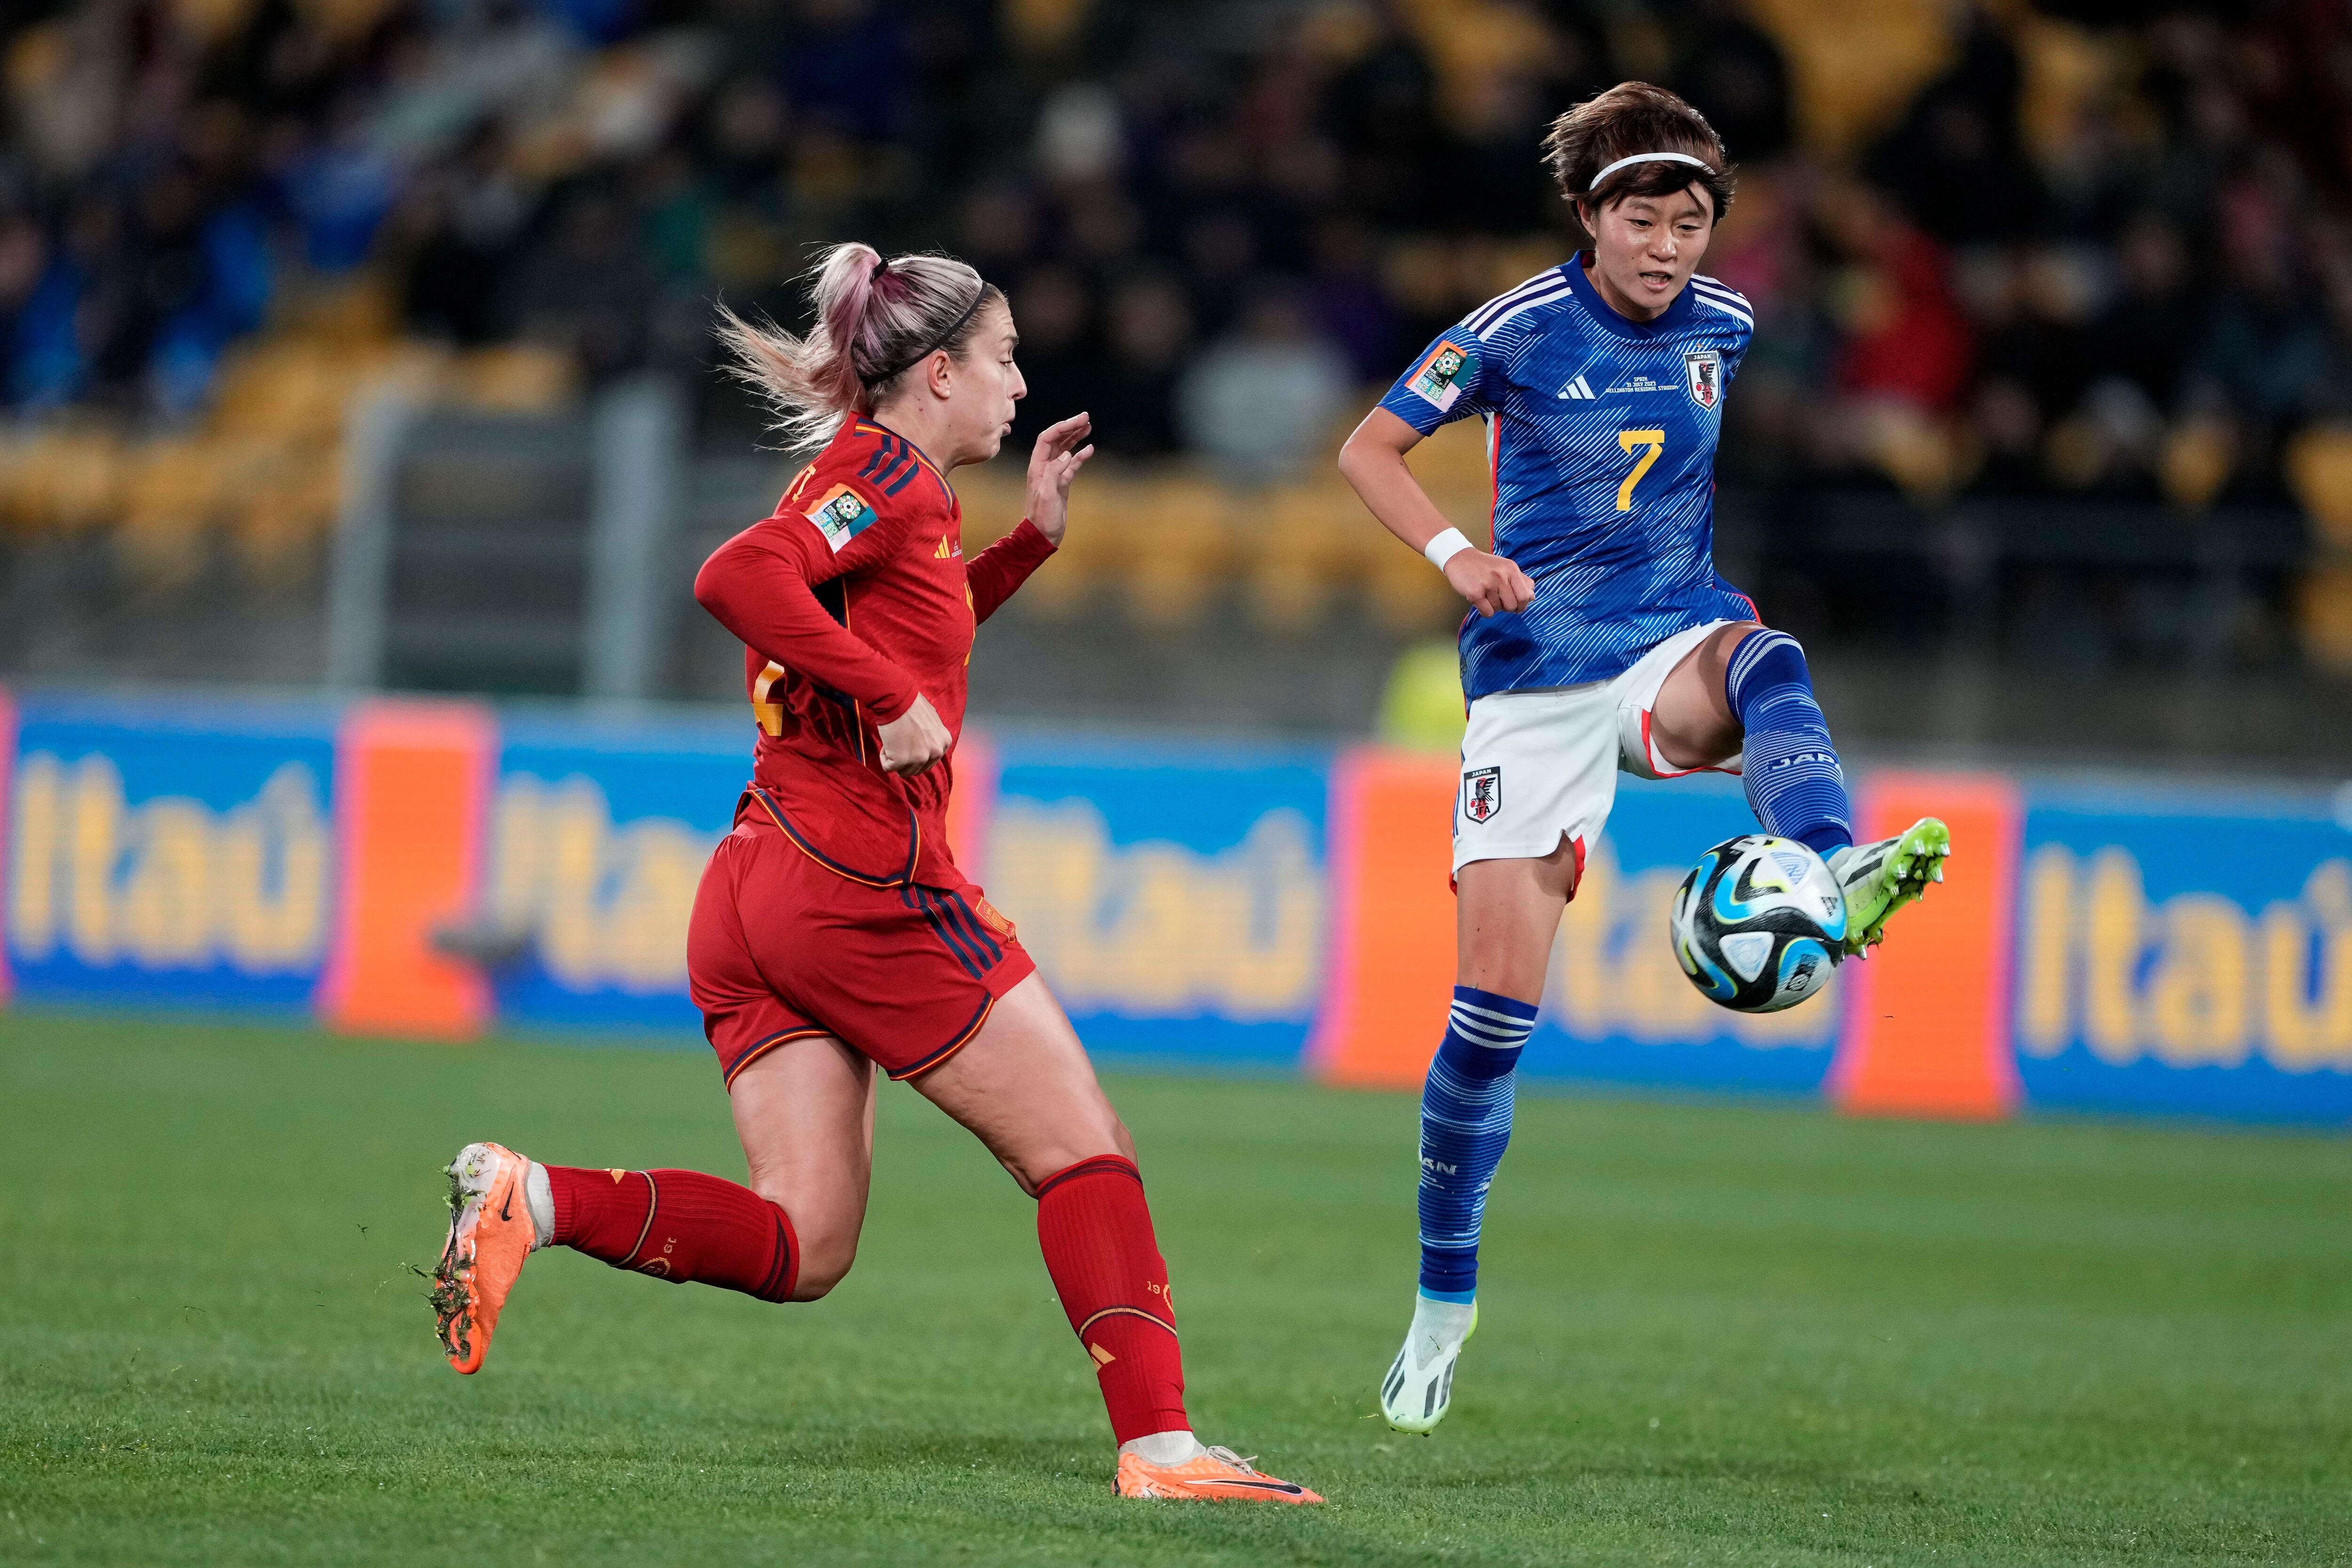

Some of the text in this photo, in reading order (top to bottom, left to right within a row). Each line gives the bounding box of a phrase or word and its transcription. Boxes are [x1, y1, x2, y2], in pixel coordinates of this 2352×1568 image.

[1425, 373, 1436, 382] WORLD
[1616, 430, 1665, 511] 7
[1471, 769, 1492, 777] JAPAN
[496, 775, 710, 993] Ita
